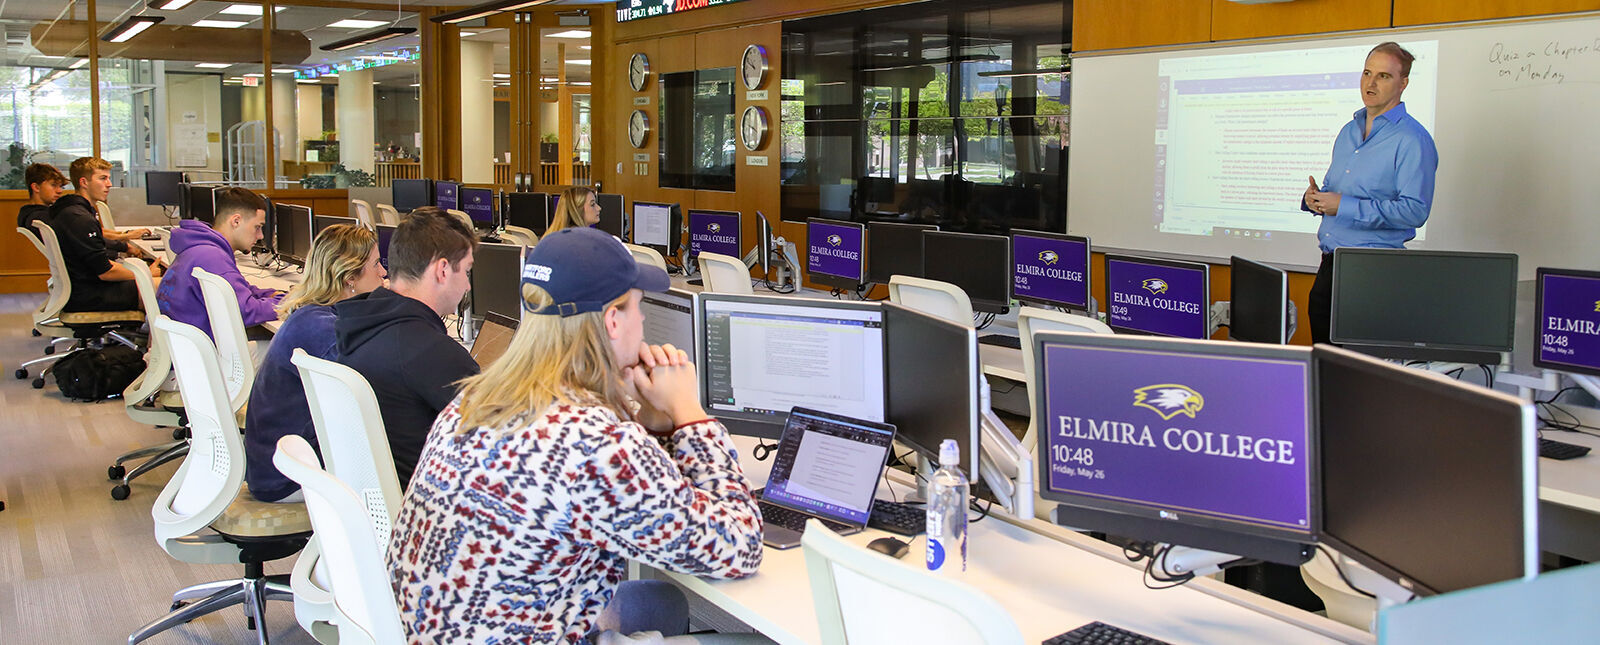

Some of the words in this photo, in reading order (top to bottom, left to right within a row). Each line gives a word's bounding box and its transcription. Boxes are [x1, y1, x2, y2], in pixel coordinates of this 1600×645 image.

[1489, 42, 1519, 64] Quiz
[1544, 41, 1588, 60] Chapter
[1514, 63, 1565, 85] Monday
[692, 233, 711, 242] ELMIRA
[712, 235, 737, 244] COLLEGE
[811, 245, 831, 256] ELMIRA
[832, 249, 859, 261] COLLEGE
[1016, 263, 1045, 277] ELMIRA
[1046, 267, 1083, 282] COLLEGE
[1114, 292, 1151, 307] ELMIRA
[1152, 297, 1200, 315] COLLEGE
[1543, 333, 1569, 347] 10:48
[1058, 415, 1156, 447] ELMIRA
[1162, 428, 1295, 465] COLLEGE
[1052, 444, 1094, 466] 10:48
[1052, 463, 1076, 476] Friday,
[1077, 467, 1094, 479] May
[1094, 469, 1105, 480] 26
